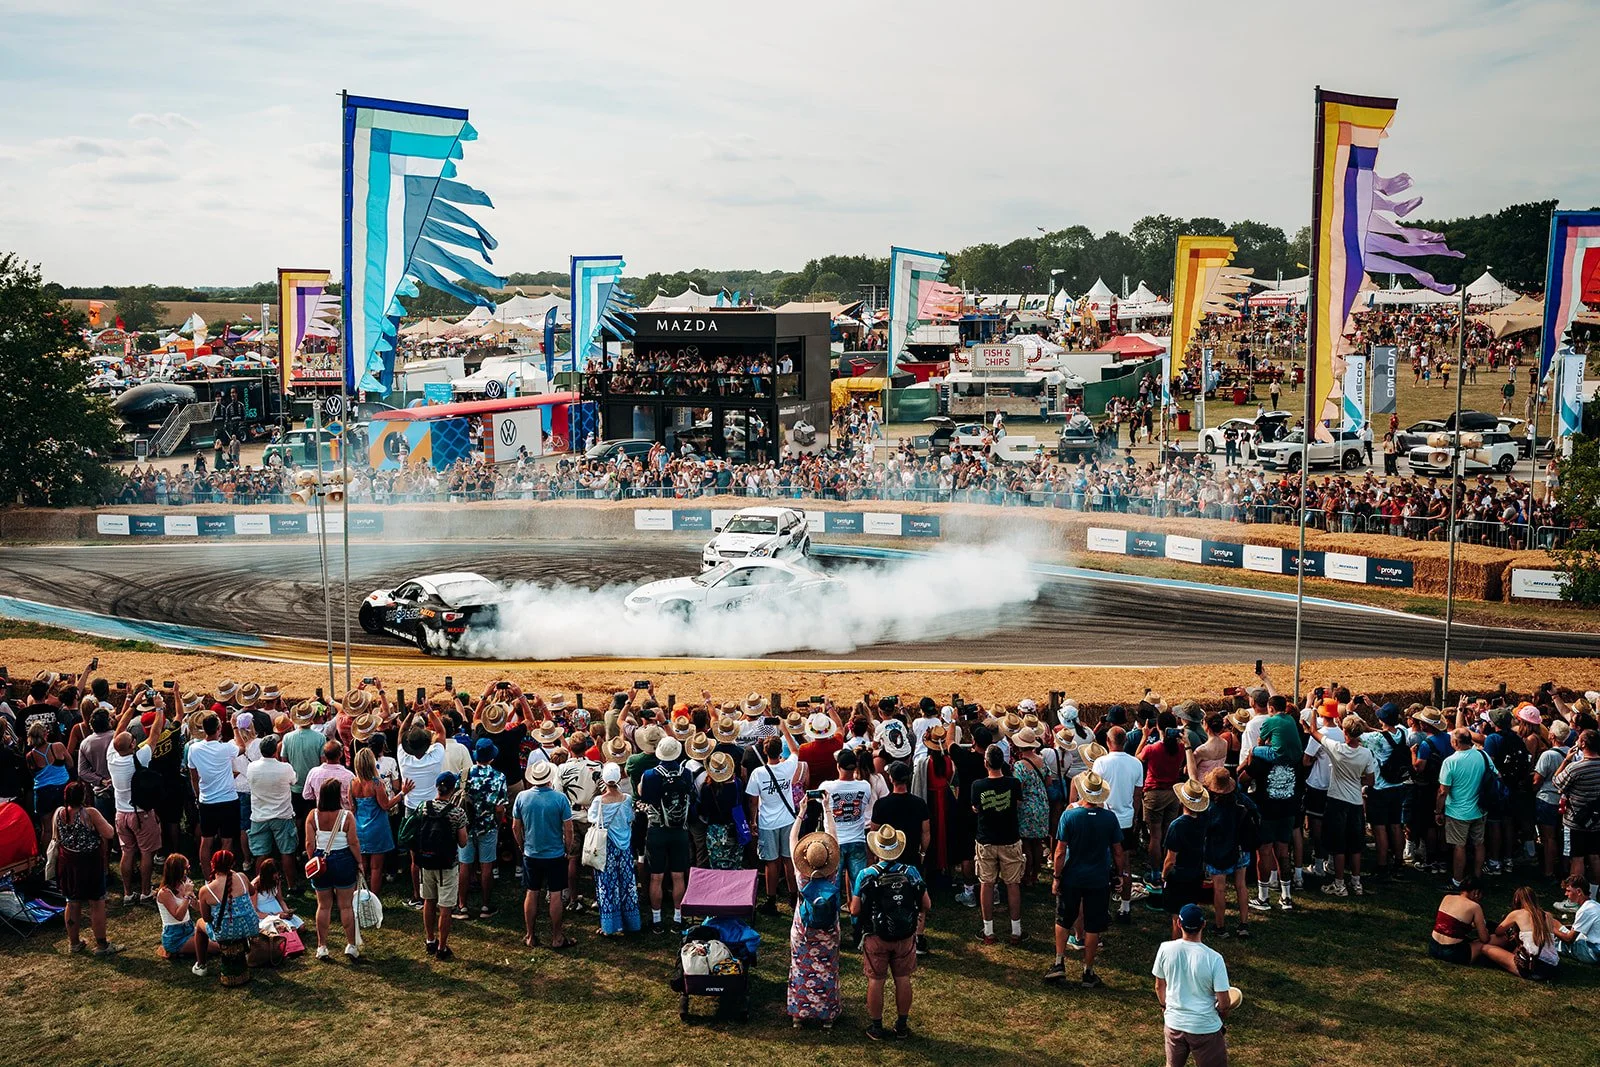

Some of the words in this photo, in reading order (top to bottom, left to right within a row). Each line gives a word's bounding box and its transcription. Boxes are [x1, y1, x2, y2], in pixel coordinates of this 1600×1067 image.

[656, 319, 718, 331] MAZDA
[983, 349, 1003, 357] FISH
[1004, 349, 1011, 357] &
[985, 358, 1010, 366] CHIPS
[302, 370, 325, 378] STEAK
[325, 370, 343, 378] FRIT
[1214, 547, 1234, 557] protyre
[1380, 565, 1403, 576] protyre
[27, 711, 56, 721] ASTRO
